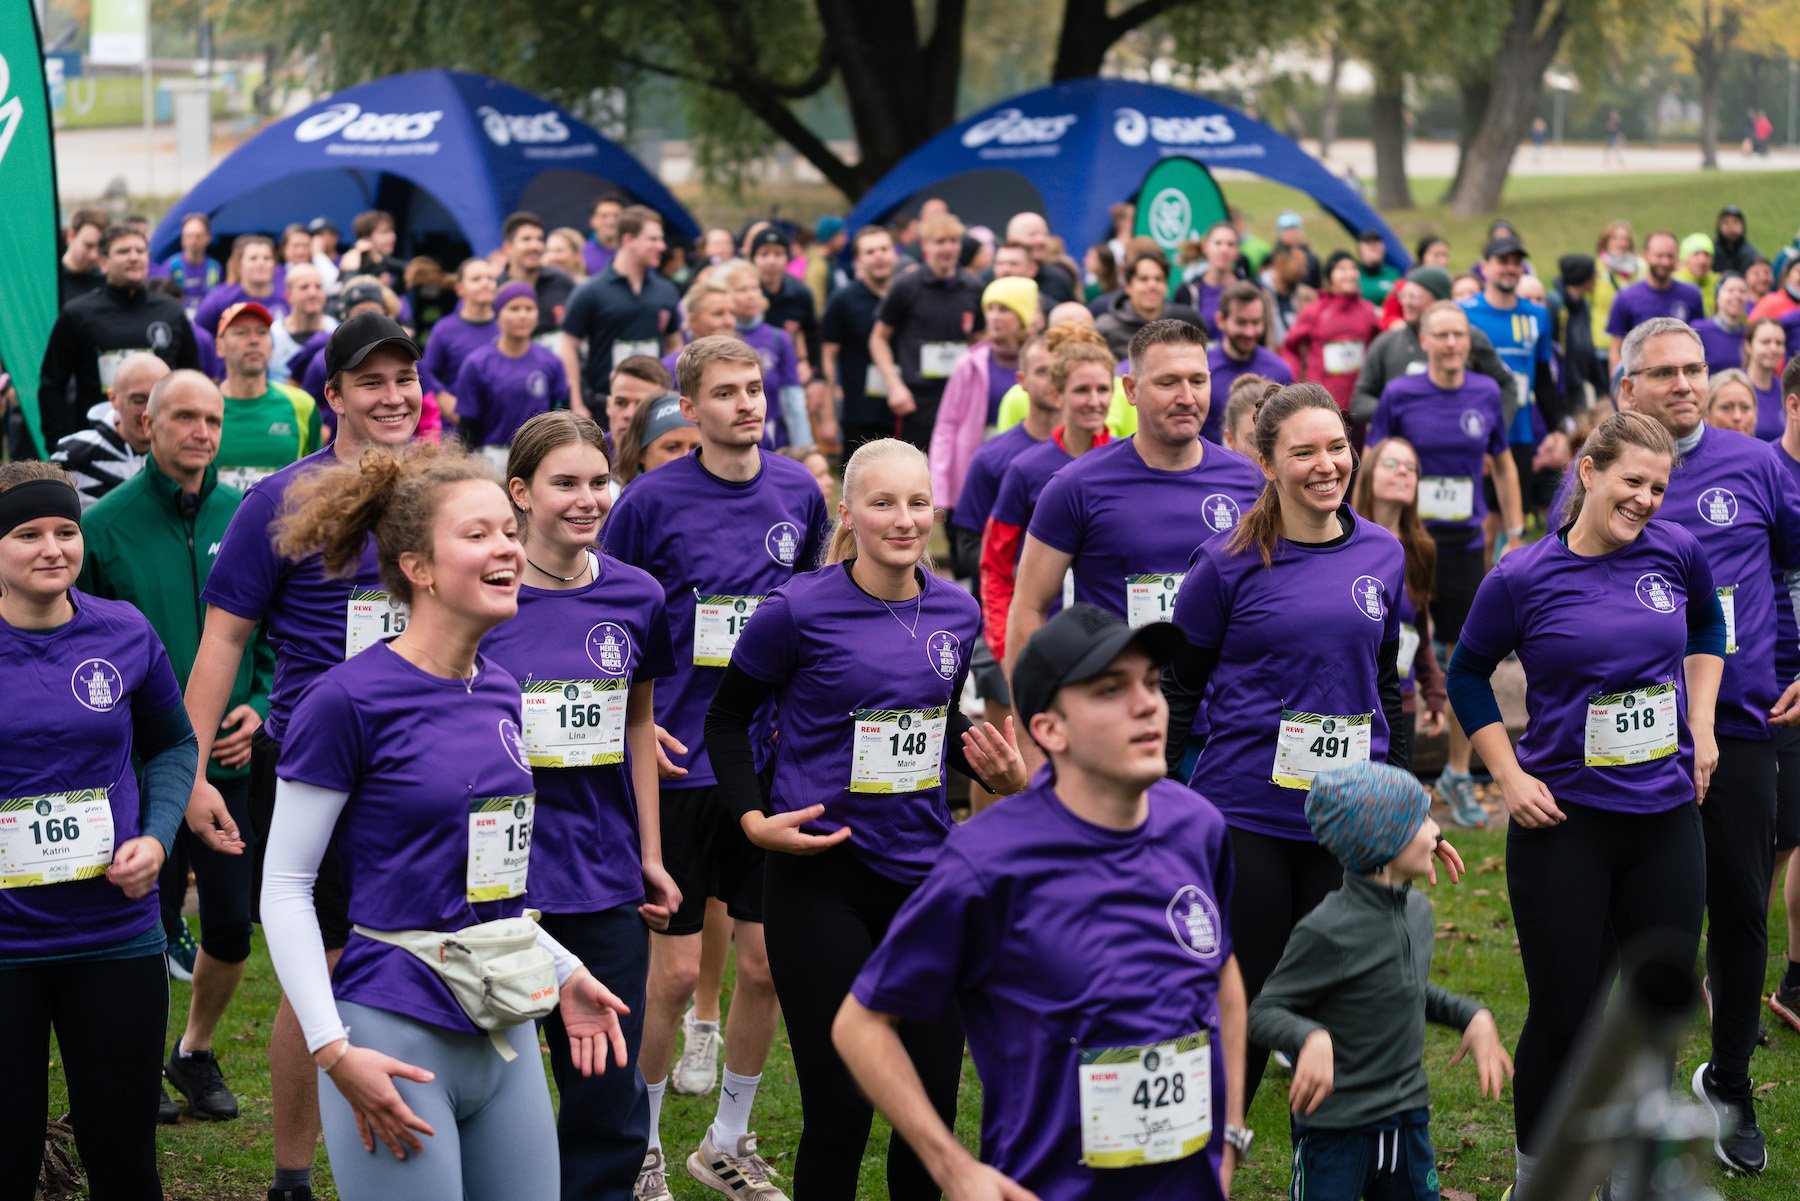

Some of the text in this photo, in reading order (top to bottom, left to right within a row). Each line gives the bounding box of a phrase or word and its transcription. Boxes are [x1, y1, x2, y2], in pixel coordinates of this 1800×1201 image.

[1149, 114, 1236, 144] asics
[601, 658, 622, 668] ROCKS
[556, 704, 601, 728] 156
[1616, 707, 1655, 733] 518
[568, 732, 586, 740] Lina
[889, 732, 927, 756] 148
[1310, 736, 1350, 758] 491
[897, 759, 916, 768] Marie
[28, 816, 80, 845] 166
[42, 845, 70, 856] Katrin
[1132, 1072, 1185, 1109] 428
